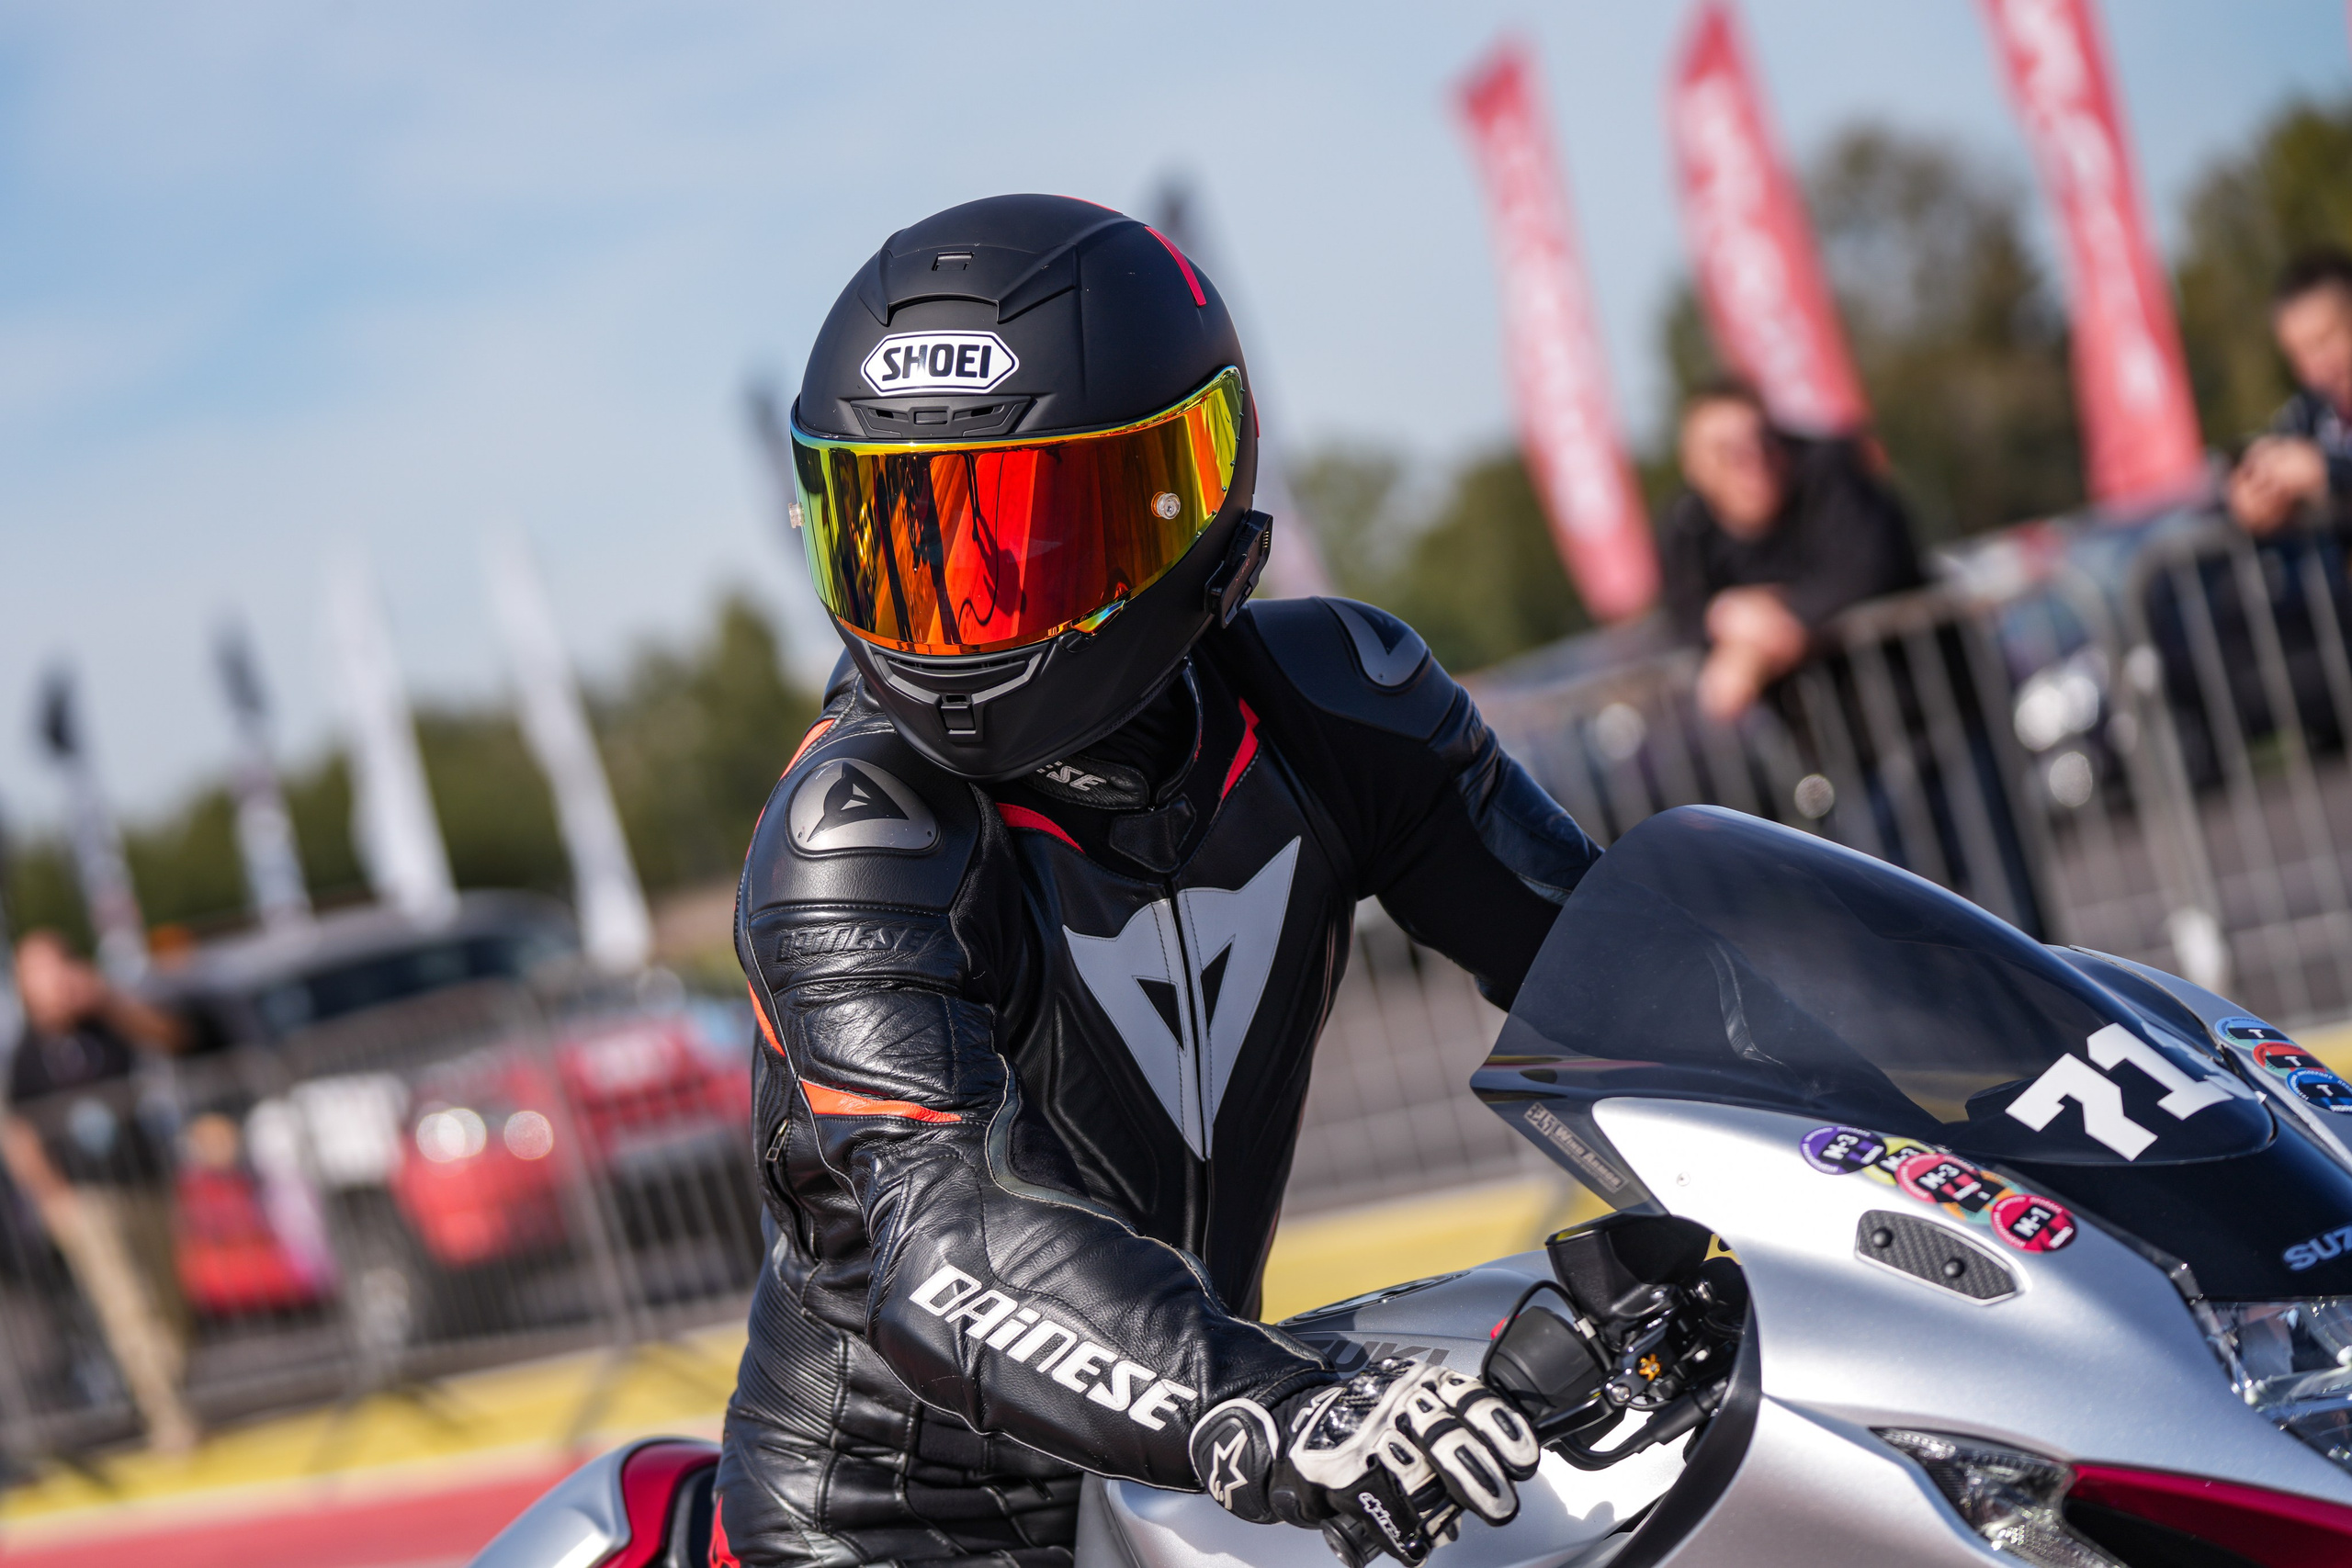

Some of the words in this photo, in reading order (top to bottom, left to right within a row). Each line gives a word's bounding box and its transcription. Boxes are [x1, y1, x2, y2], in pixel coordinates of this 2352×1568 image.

[882, 344, 992, 381] SHOEI
[2005, 1021, 2233, 1162] 71
[1822, 1134, 1860, 1160] M-3
[1918, 1164, 1960, 1190] M-3
[2013, 1206, 2052, 1237] M-1
